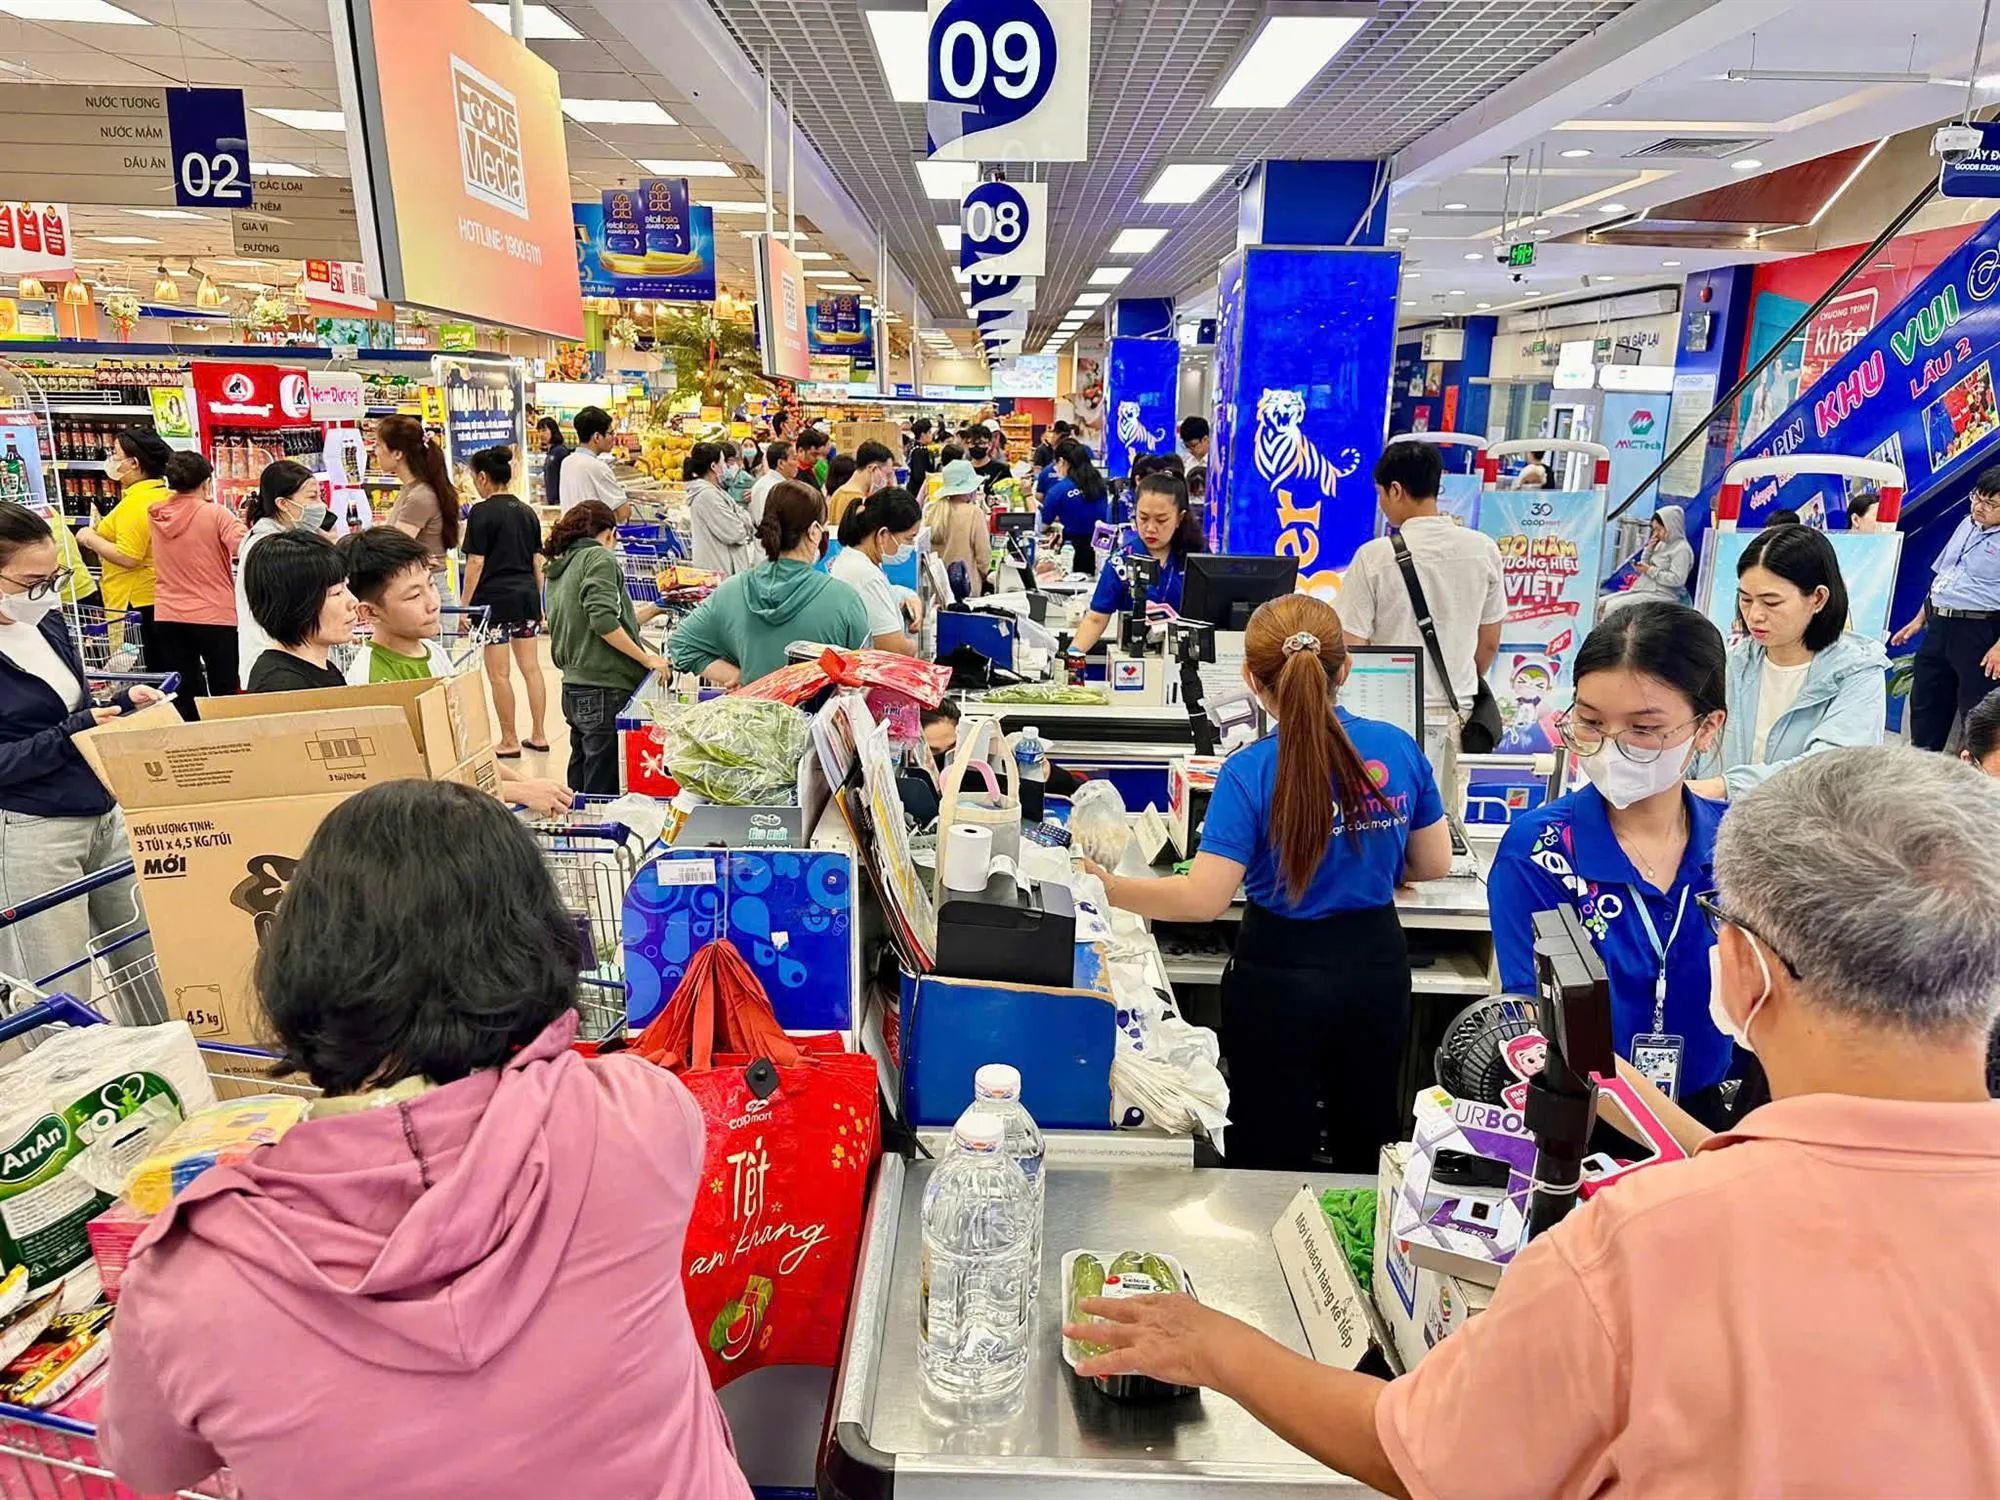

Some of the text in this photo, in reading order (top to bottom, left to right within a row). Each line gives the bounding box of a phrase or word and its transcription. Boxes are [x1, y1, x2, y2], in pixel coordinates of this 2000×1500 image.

[939, 20, 1041, 99] 09
[85, 96, 117, 109] NƯỚC
[100, 125, 132, 139] NƯỚC
[181, 151, 242, 199] 02
[463, 130, 525, 203] Media
[241, 222, 258, 232] GIA
[966, 201, 1021, 243] 08
[1891, 284, 1961, 365] VUI
[1909, 337, 1972, 399] LẦU 2
[1814, 351, 1886, 437] KHU
[1773, 417, 1806, 457] PIN
[1531, 503, 1553, 516] 30
[1532, 534, 1578, 560] NĂM
[1504, 570, 1564, 604] VIỆT
[329, 772, 367, 783] 3 túi/thùng
[133, 820, 215, 837] KHỐI LƯỢNG TỊNH:
[136, 833, 232, 852] 3 TÚI x 4,5 KG/TÚI
[143, 853, 187, 876] MỚI
[206, 1013, 219, 1026] kg
[1455, 1103, 1530, 1136] URBO
[1, 1126, 63, 1176] AnAn
[726, 1136, 772, 1223] Tết
[688, 1218, 831, 1278] an khang
[1304, 1234, 1323, 1274] khách
[1317, 1270, 1338, 1307] hàng
[1330, 1298, 1347, 1323] kế
[1337, 1316, 1354, 1349] tiếp
